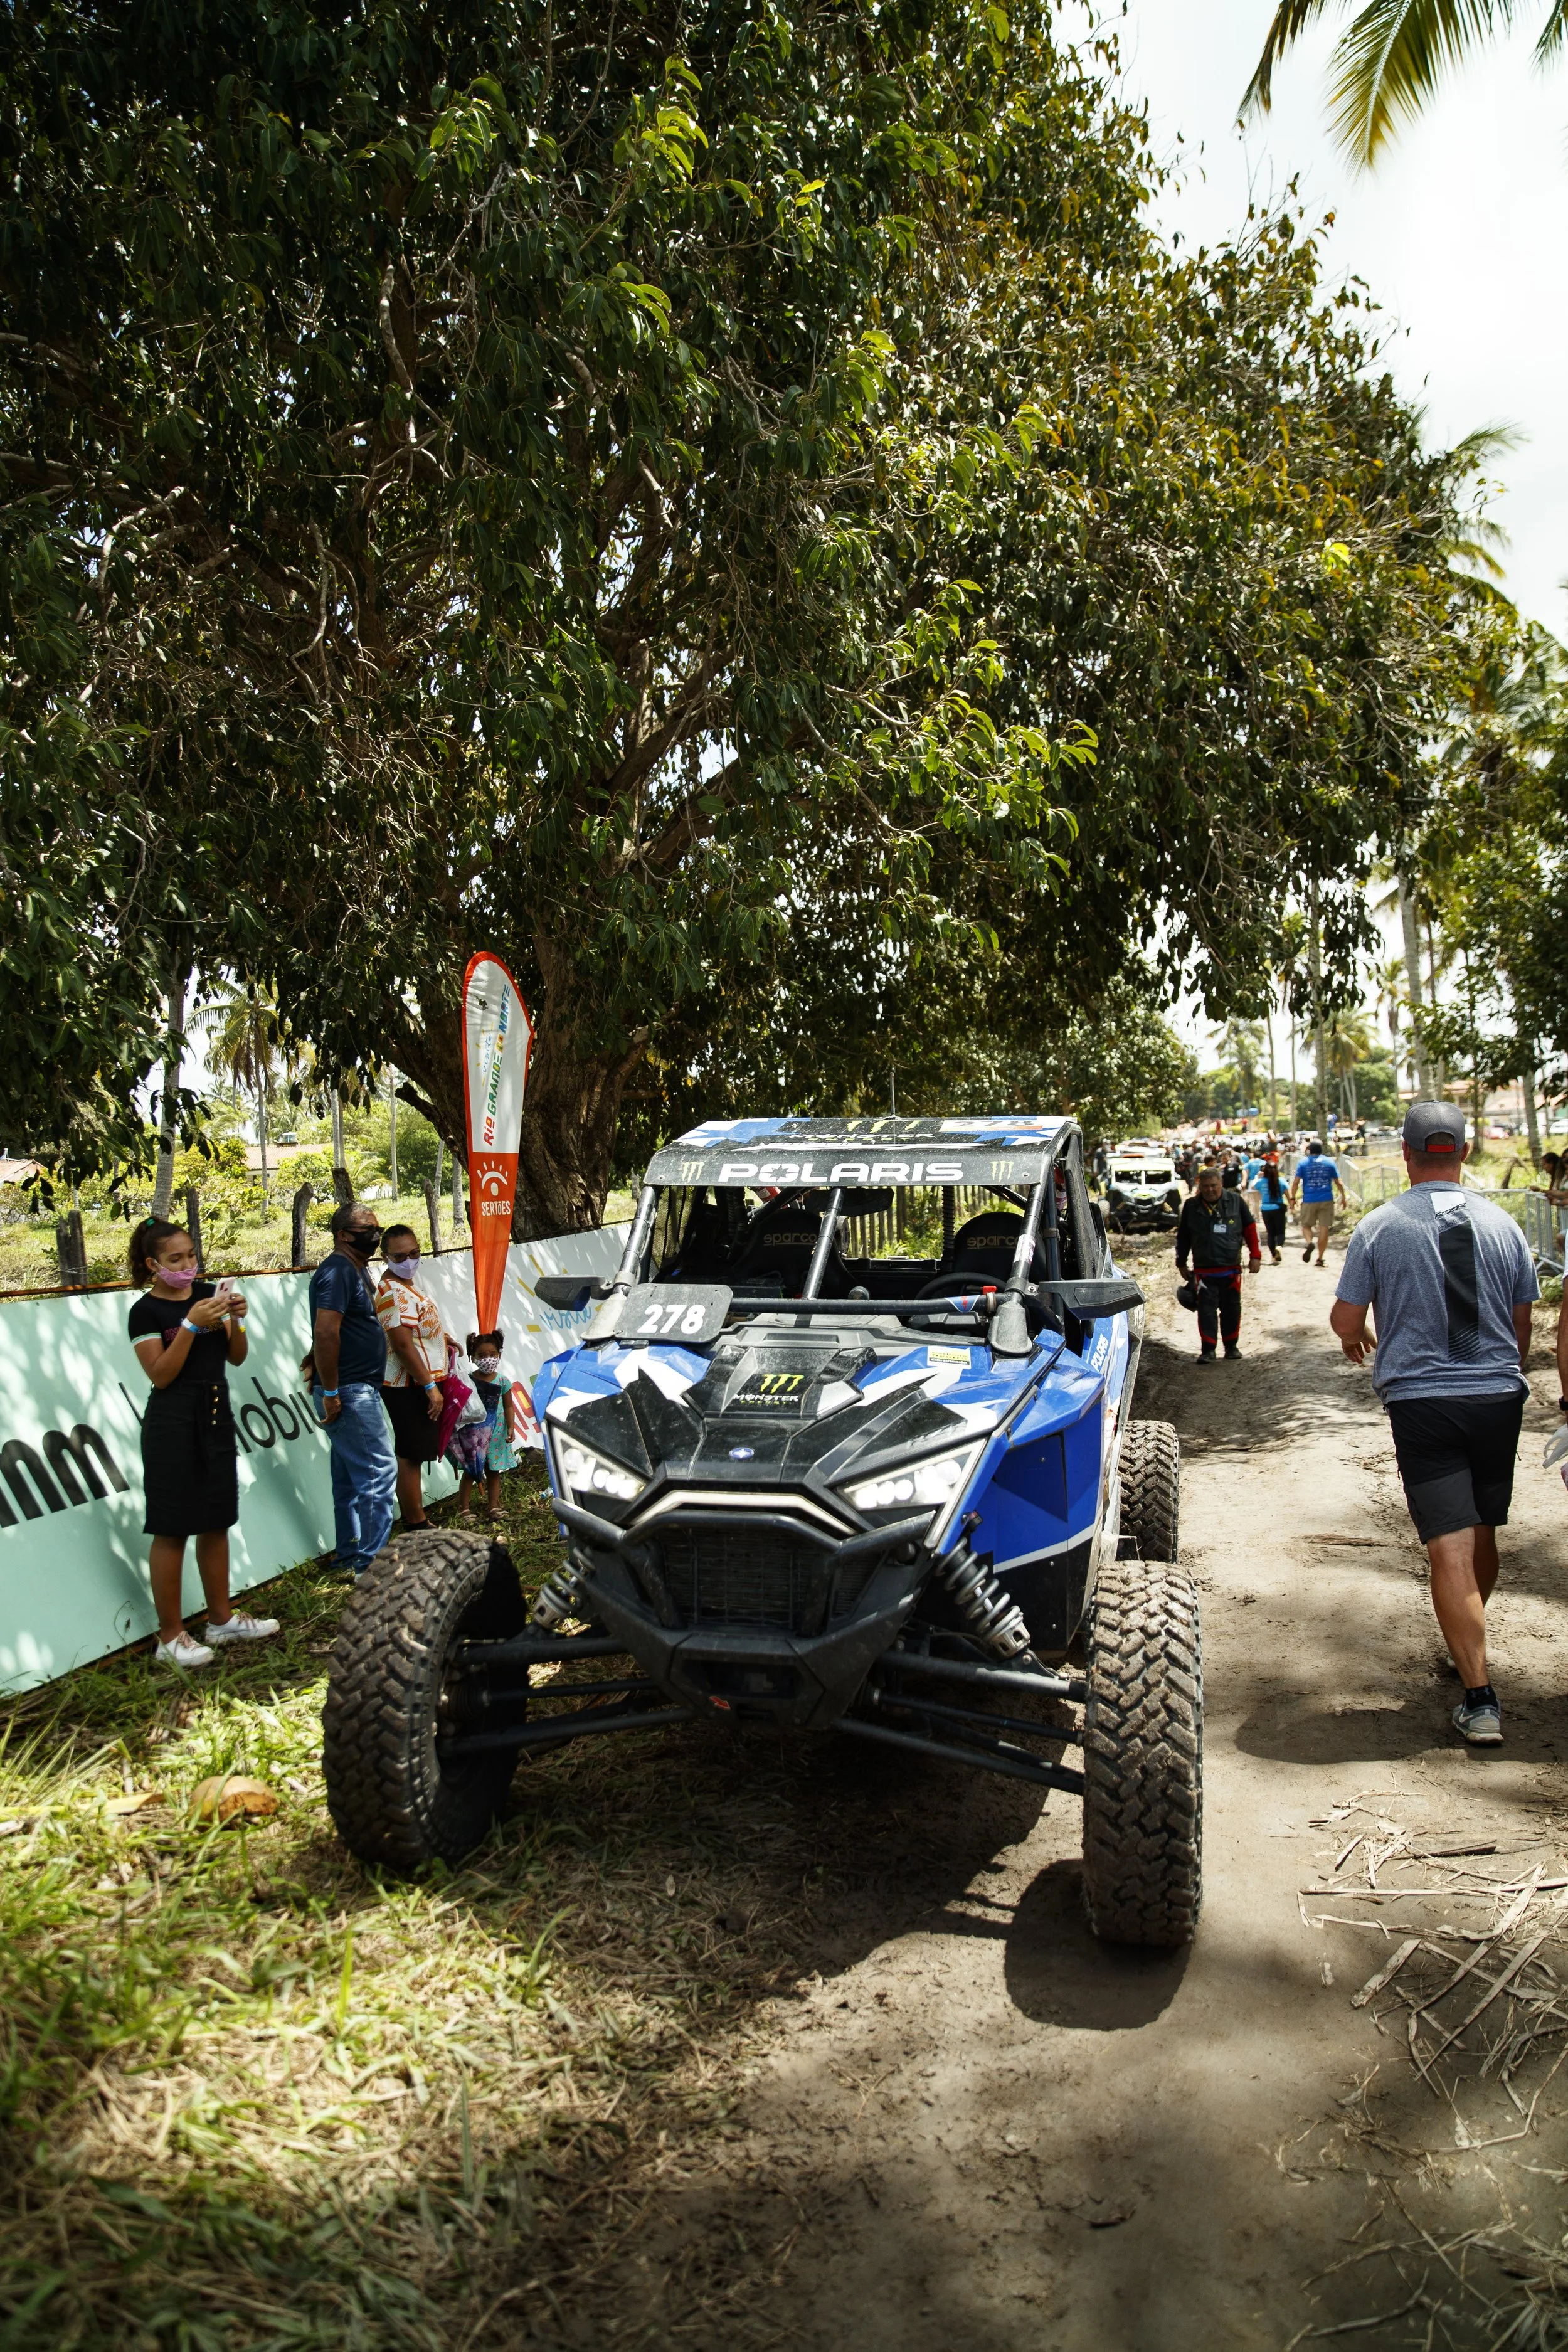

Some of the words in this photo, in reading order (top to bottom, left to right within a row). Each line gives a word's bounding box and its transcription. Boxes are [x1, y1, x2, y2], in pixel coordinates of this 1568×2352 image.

[487, 1052, 502, 1116] GRANDE
[498, 983, 511, 1034] NORTE
[718, 1162, 964, 1182] POLARIS
[481, 1200, 511, 1216] SERTÕES
[763, 1232, 817, 1247] sparco
[637, 1304, 706, 1335] 278
[1091, 1333, 1109, 1372] POLARIS
[733, 1394, 799, 1402] MONSTER
